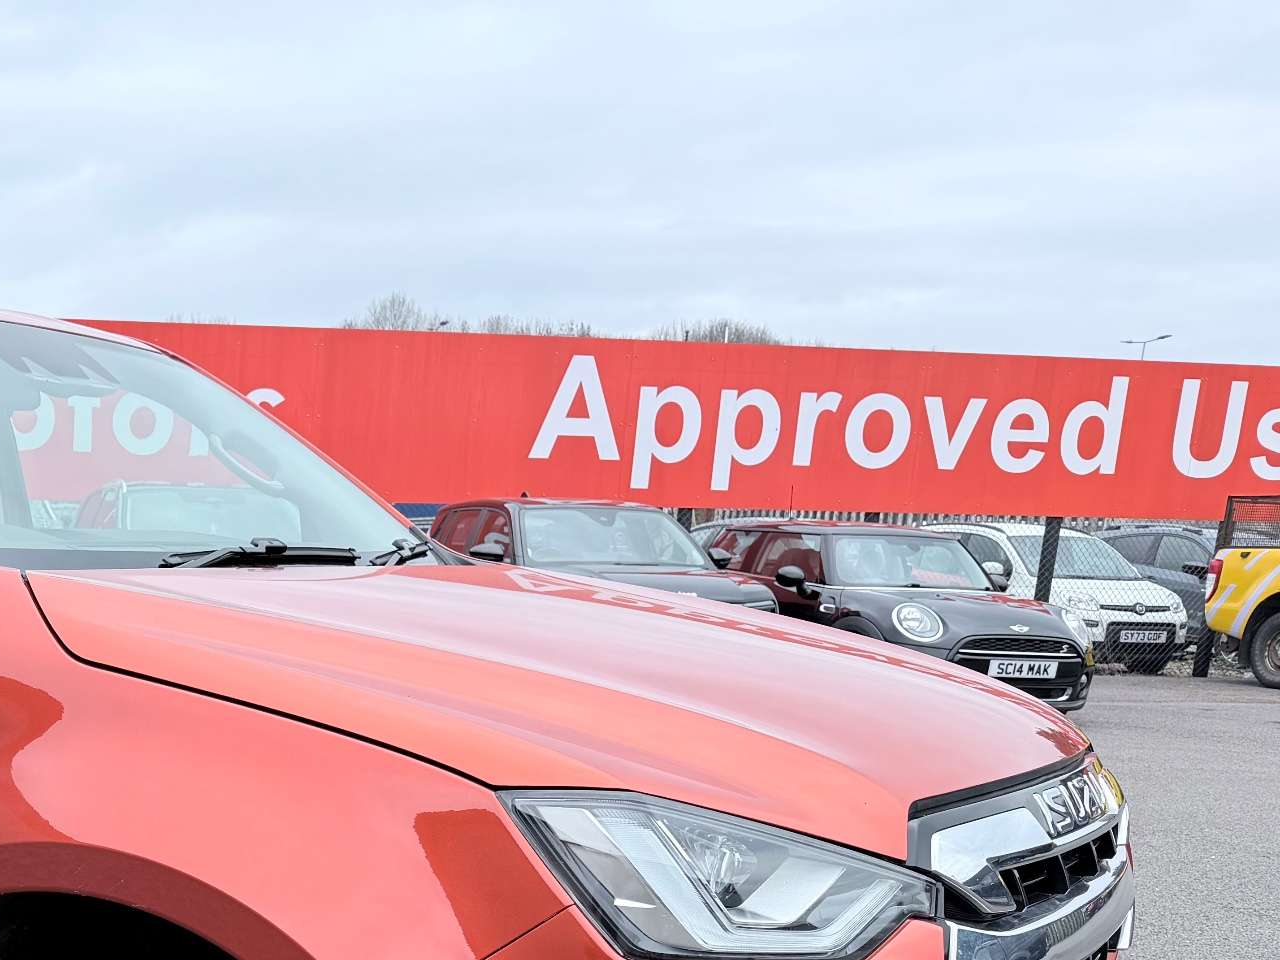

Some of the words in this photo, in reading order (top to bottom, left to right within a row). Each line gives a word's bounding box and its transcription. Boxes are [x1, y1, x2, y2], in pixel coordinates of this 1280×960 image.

[529, 354, 1130, 491] Approved
[996, 662, 1024, 675] SC14
[1026, 663, 1051, 676] MAK
